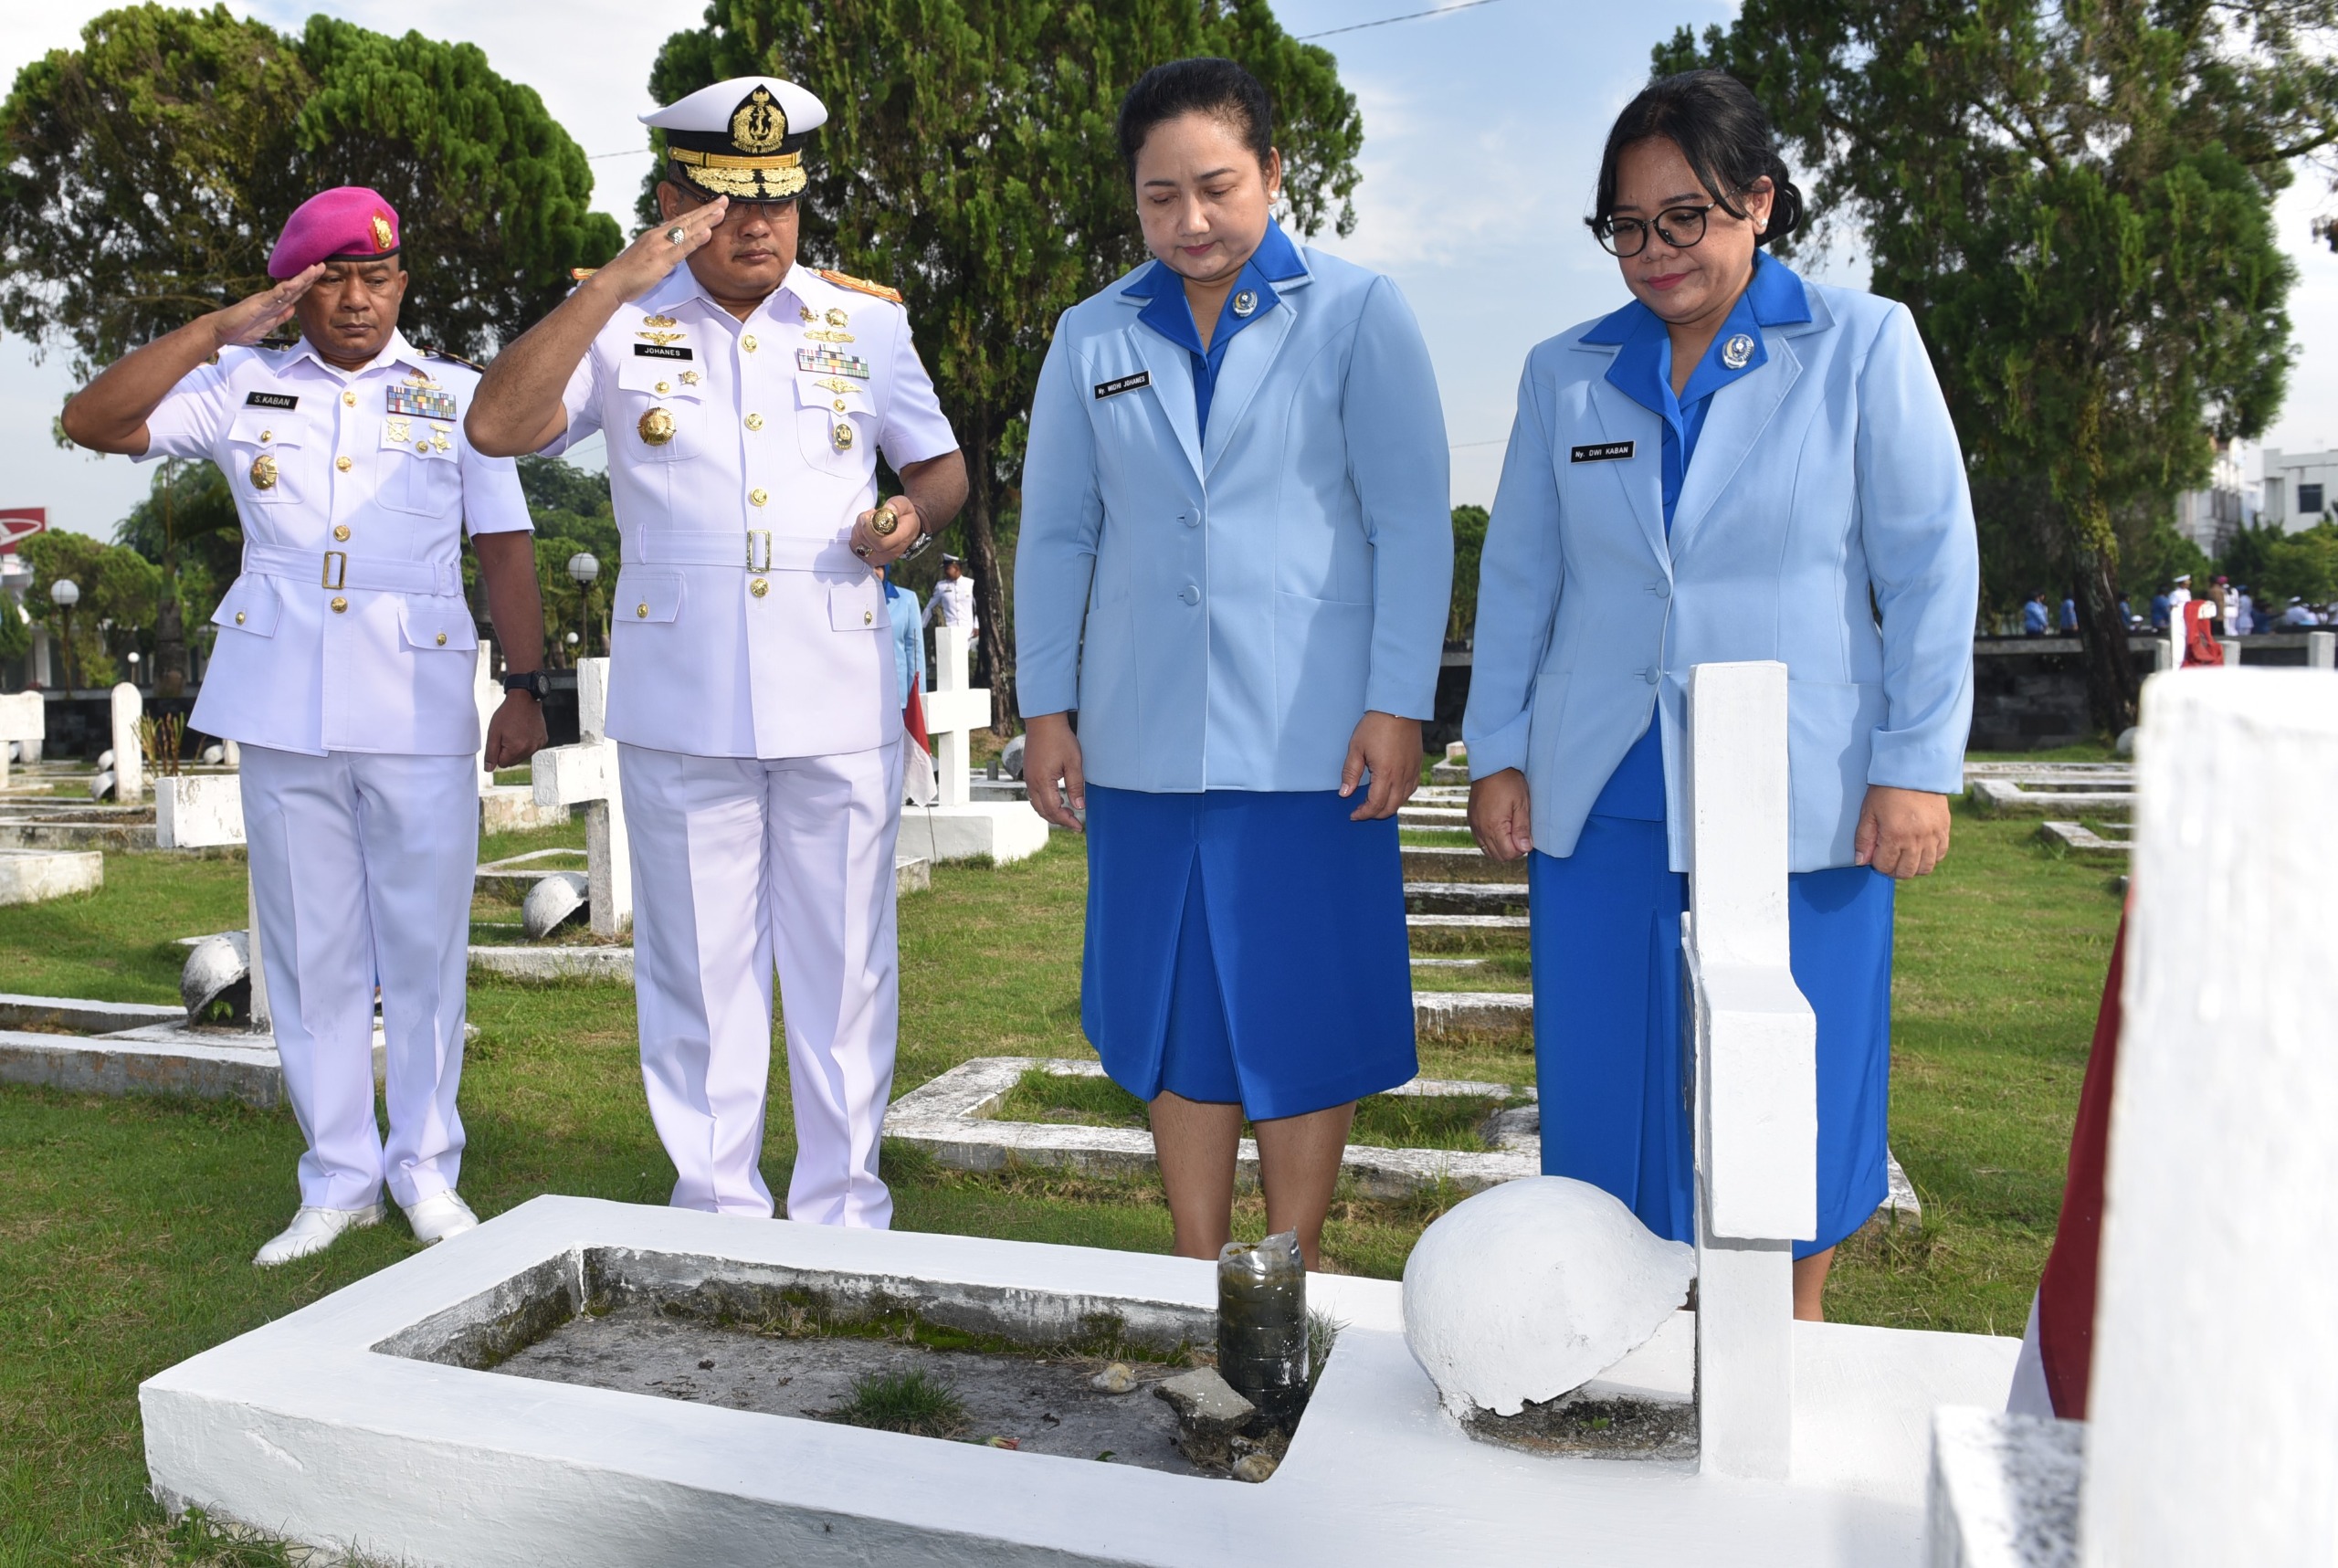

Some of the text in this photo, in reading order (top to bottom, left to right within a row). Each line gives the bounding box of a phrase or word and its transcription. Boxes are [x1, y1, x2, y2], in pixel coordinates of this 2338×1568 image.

[644, 347, 680, 356] JOHANES
[1107, 382, 1122, 392] WIDHI
[1123, 375, 1145, 387] JOHANES
[1575, 446, 1628, 458] Ny. DWI KABAN
